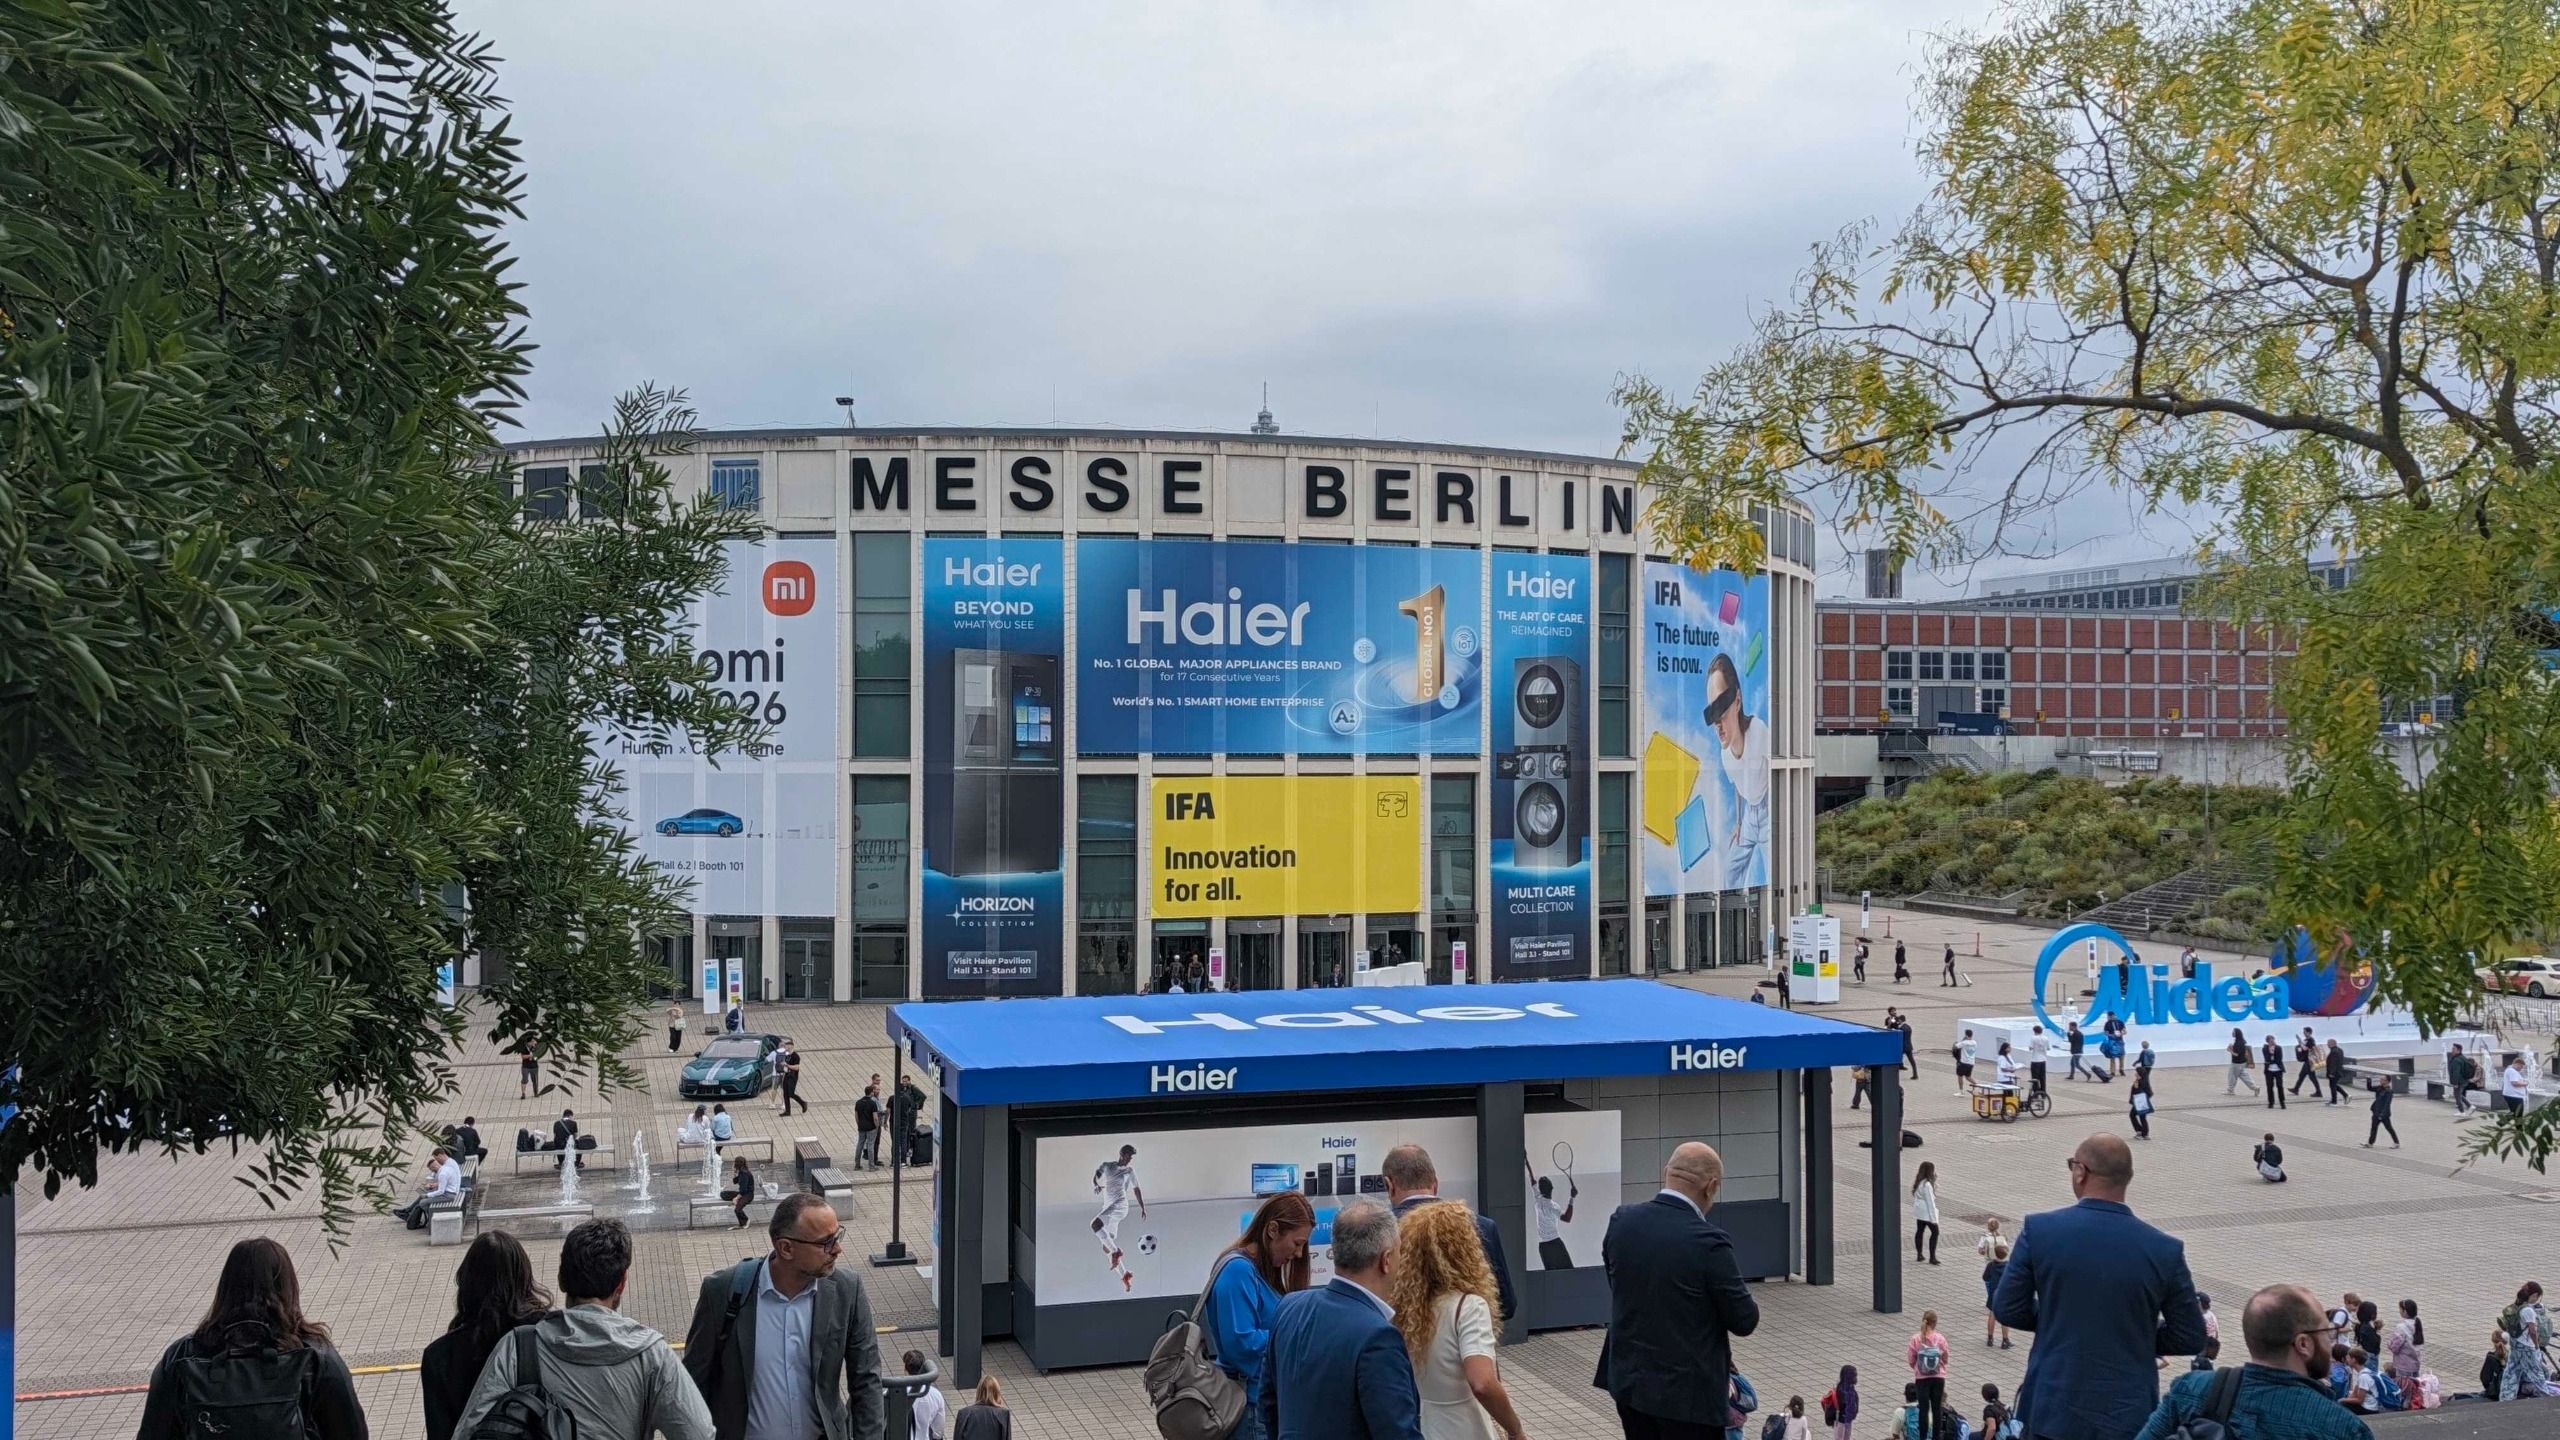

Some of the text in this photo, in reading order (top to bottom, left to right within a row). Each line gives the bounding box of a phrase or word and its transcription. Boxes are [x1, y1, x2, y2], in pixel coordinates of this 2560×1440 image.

[852, 456, 1635, 534] MESSE BERLIN
[945, 556, 1042, 587] Haier
[1507, 570, 1576, 599] Haier
[1655, 581, 1681, 606] IFA
[954, 601, 1034, 615] BEYOND
[1127, 586, 1311, 646] Haier
[1497, 610, 1518, 621] THE
[1520, 611, 1540, 621] ART
[1542, 612, 1556, 622] OF
[953, 620, 1035, 630] WHAT YOU SEE
[1511, 625, 1573, 637] REIMAGINED
[1655, 622, 1720, 647] The future
[1423, 606, 1434, 698] GLOBAL NO.1
[1657, 651, 1703, 674] is now.
[1093, 658, 1342, 671] No. 1 GLOBAL MAJOR APPLIANCES BRAND
[1160, 672, 1281, 682] for 17 Consecutive Years
[715, 690, 787, 725] 026
[1157, 697, 1175, 706] No.
[1177, 697, 1182, 706] 1
[1184, 697, 1223, 706] SMART
[1225, 697, 1258, 707] HOME
[1260, 697, 1325, 708] ENTERPRISE
[622, 740, 673, 755] Human
[1166, 792, 1216, 820] IFA
[659, 860, 675, 870] Hall
[678, 861, 691, 870] 6.2
[699, 861, 727, 871] Booth
[729, 861, 744, 871] 101
[1165, 845, 1296, 870] Innovation
[1165, 877, 1242, 902] for all.
[1508, 885, 1576, 899] MULTI CARE
[961, 897, 1034, 911] HORIZON
[1510, 901, 1574, 914] COLLECTION
[953, 957, 1031, 965] Visit Haier Pavilion
[953, 966, 970, 974] Hall
[992, 966, 1016, 974] Stand
[1019, 966, 1031, 974] 101
[2080, 961, 2289, 1028] Midea
[1102, 1002, 1579, 1034] Haier
[1670, 1042, 1747, 1071] Haier
[1150, 1062, 1238, 1093] Haier
[1321, 1136, 1357, 1149] Haier
